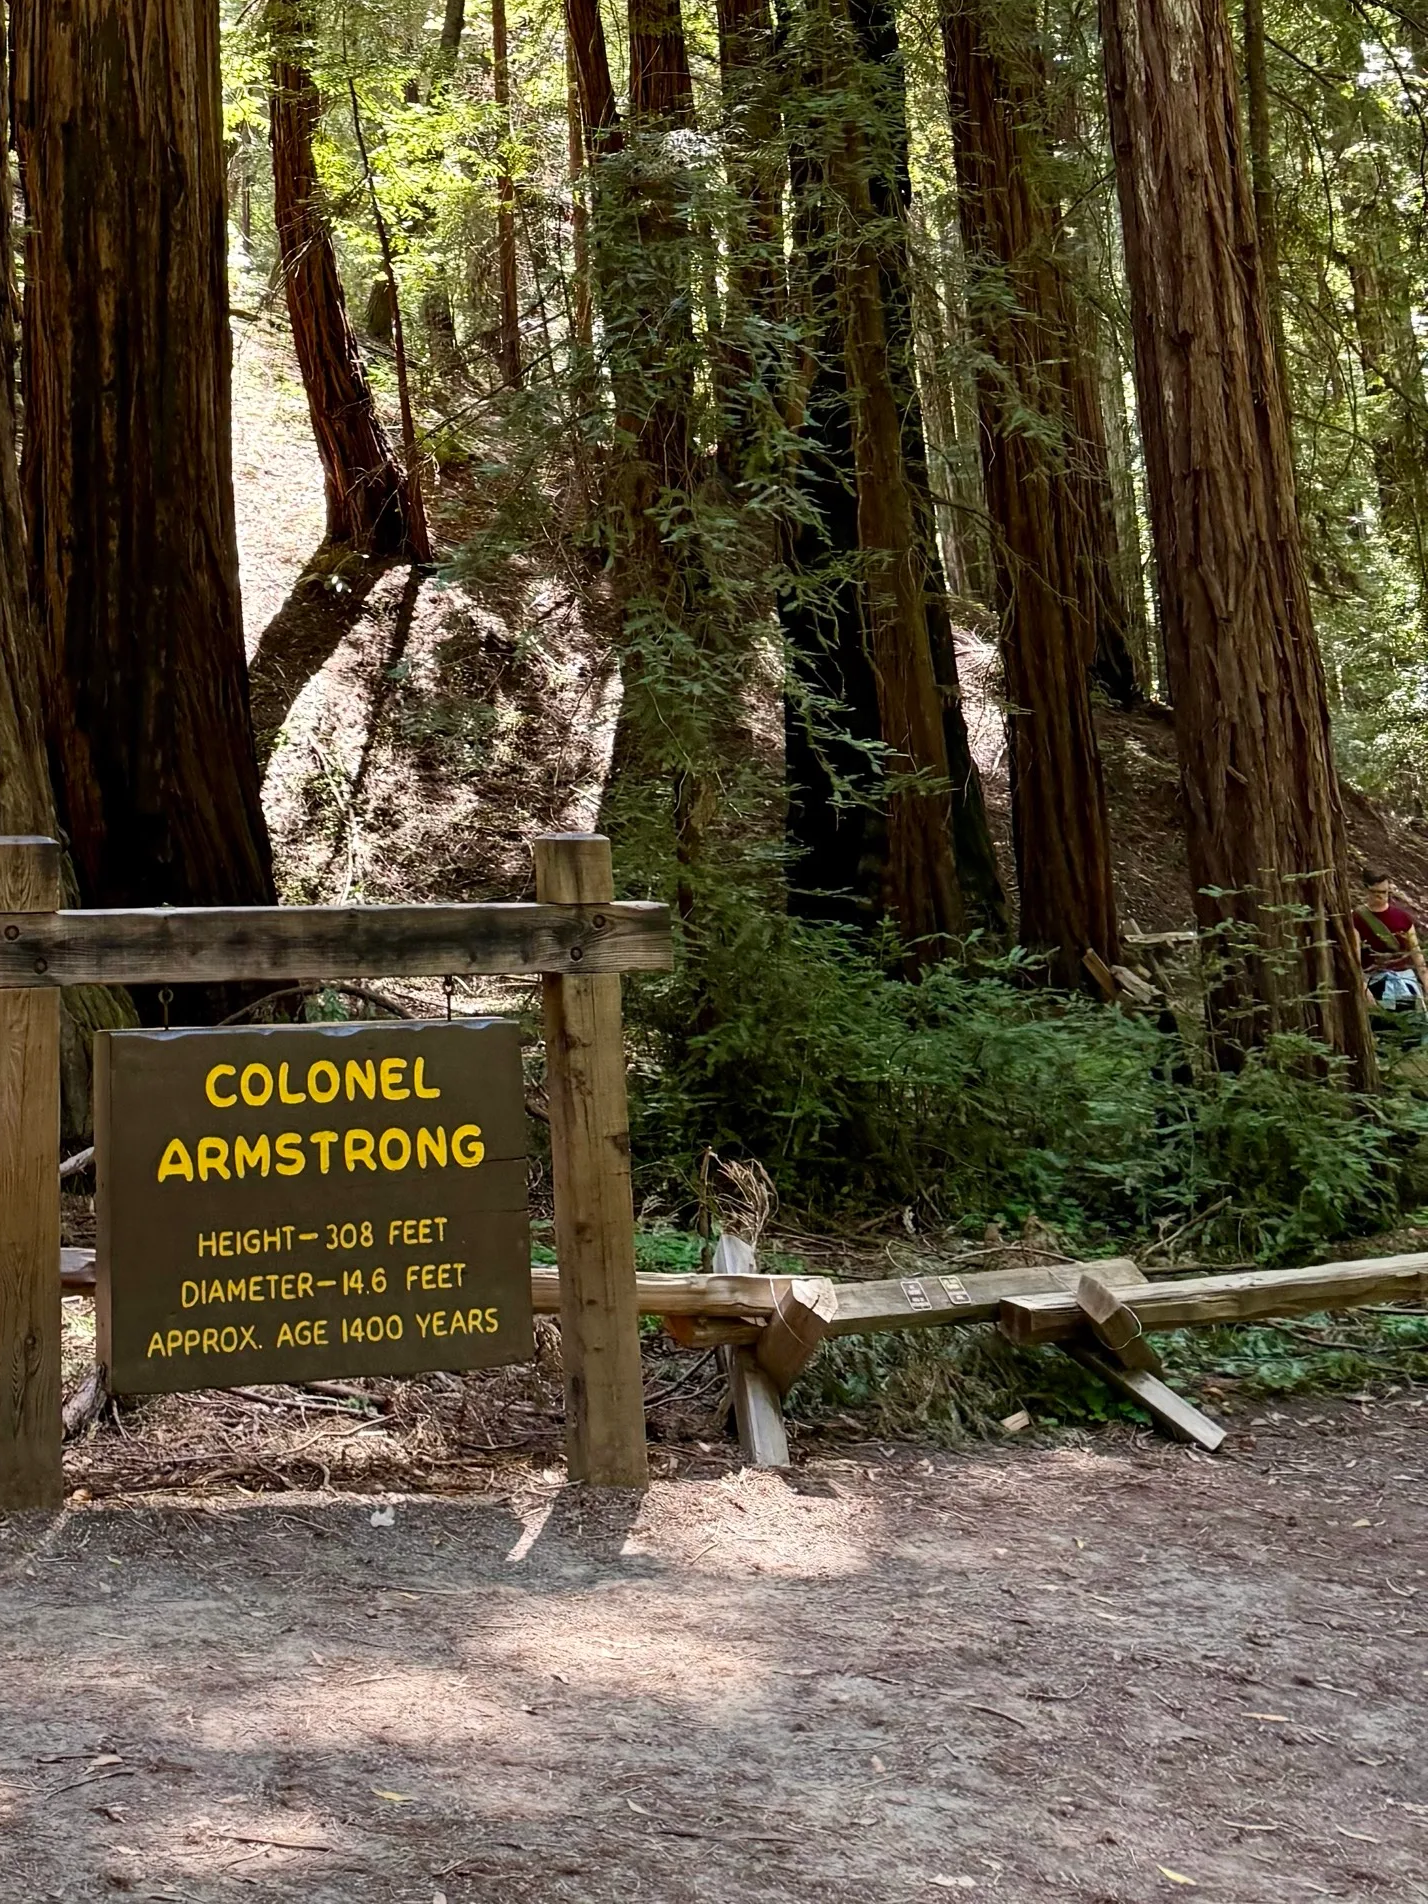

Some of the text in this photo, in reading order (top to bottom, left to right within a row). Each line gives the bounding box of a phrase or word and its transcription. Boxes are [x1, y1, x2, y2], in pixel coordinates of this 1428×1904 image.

[204, 1056, 441, 1109] COLONEL
[157, 1124, 486, 1183] ARMSTRONG
[388, 1216, 448, 1246] FEET
[405, 1262, 467, 1293] FEET
[147, 1307, 499, 1358] APPROX. AGE 1400 YEARS
